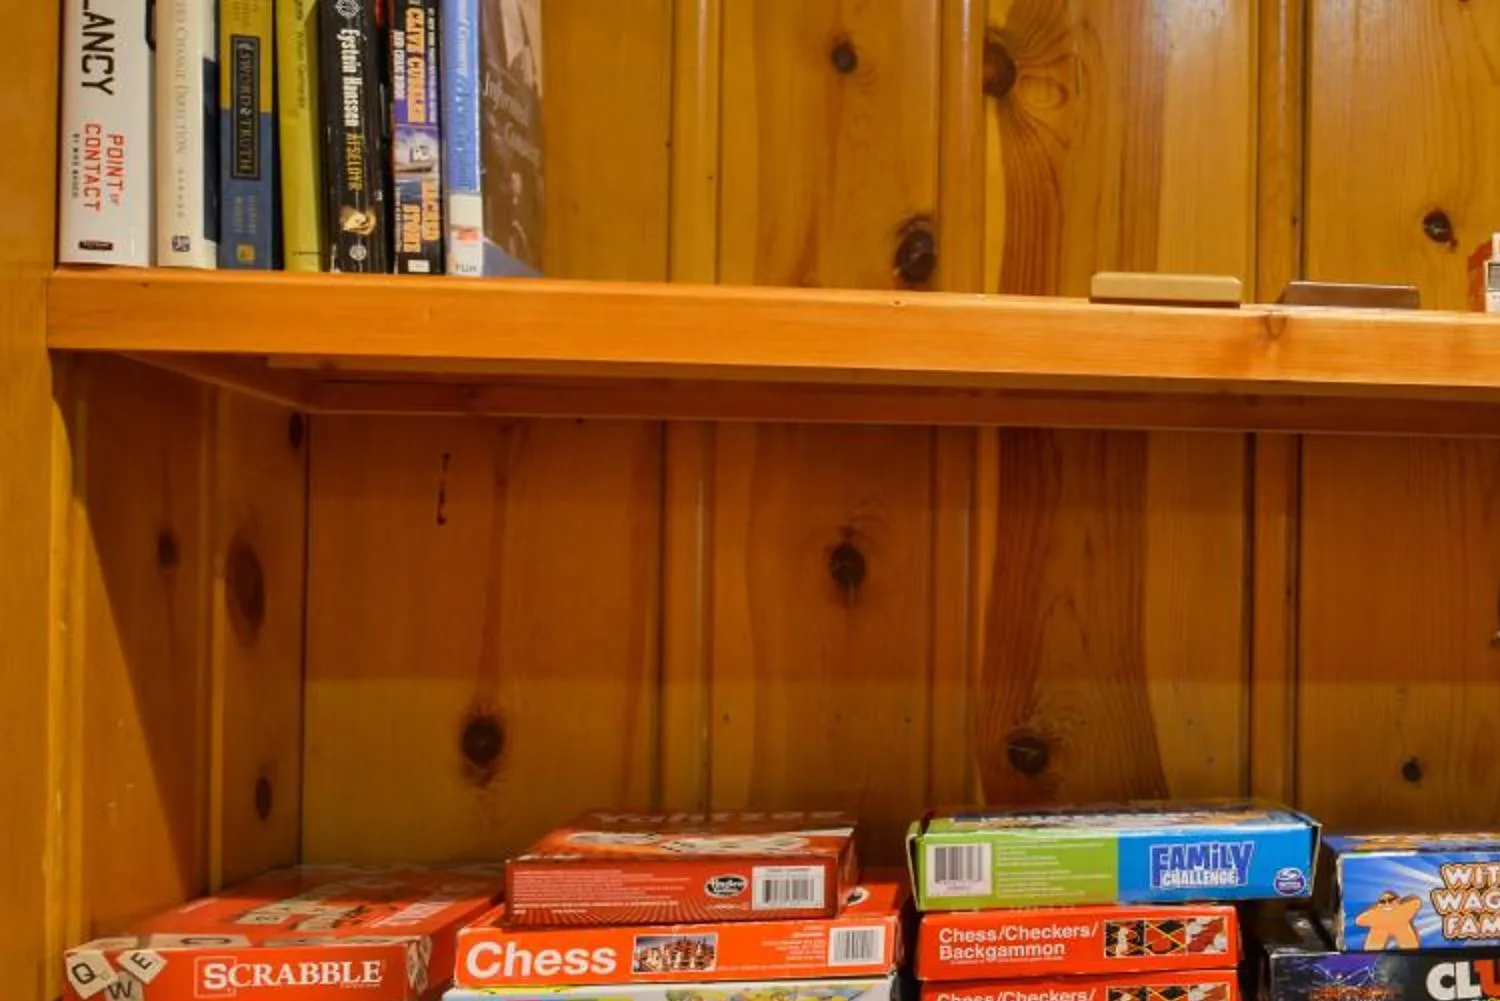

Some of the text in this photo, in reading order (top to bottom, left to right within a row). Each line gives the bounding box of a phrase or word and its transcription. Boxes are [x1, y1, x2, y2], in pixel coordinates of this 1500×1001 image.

[342, 76, 364, 127] Hanssen
[82, 122, 102, 213] CONTACT
[106, 132, 125, 191] POINT
[1161, 868, 1239, 888] CHALLENGE
[939, 921, 1099, 944] Chess/Checkers/
[466, 941, 618, 978] Chess
[939, 940, 1066, 963] Backgammon
[70, 961, 96, 986] Q
[203, 960, 383, 991] SCRABBLE
